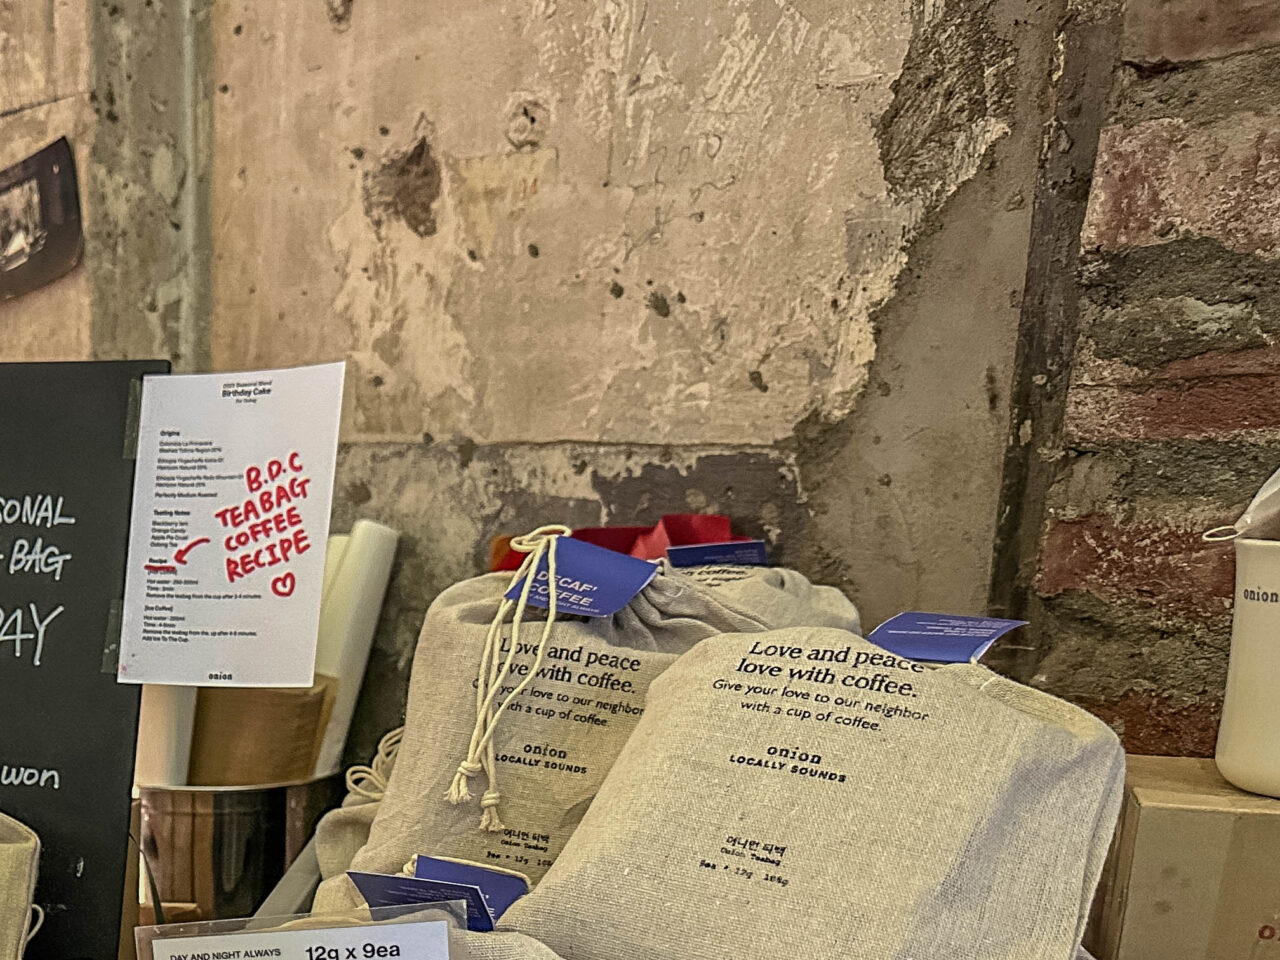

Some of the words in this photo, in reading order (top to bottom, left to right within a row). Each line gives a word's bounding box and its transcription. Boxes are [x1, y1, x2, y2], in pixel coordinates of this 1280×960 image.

[215, 477, 311, 528] TEABAG
[224, 506, 303, 552] COFFEE
[9, 538, 72, 581] BAG
[225, 529, 312, 583] RECIPE
[1244, 586, 1278, 602] onion
[547, 646, 583, 663] and
[585, 651, 641, 672] peace
[748, 641, 803, 660] Love
[807, 646, 848, 665] and
[852, 650, 926, 674] peace
[577, 672, 636, 694] coffee.
[735, 658, 782, 677] love
[788, 664, 836, 685] with
[841, 673, 918, 698] coffee.
[530, 687, 554, 700] love
[713, 679, 743, 692] Give
[744, 684, 778, 696] your
[781, 686, 811, 701] love
[814, 692, 830, 703] to
[834, 696, 861, 708] our
[864, 700, 930, 721] neighbor
[535, 706, 555, 720] cup
[740, 700, 771, 714] with
[786, 707, 812, 721] cup
[815, 710, 833, 723] of
[835, 714, 882, 732] coffee.
[523, 743, 568, 759] onion
[766, 746, 822, 766] onion
[0, 764, 61, 789] won
[495, 754, 540, 766] LOCALLY
[543, 761, 588, 774] SOUNDS
[729, 754, 787, 771] LOCALLY
[790, 765, 847, 783] SOUNDS
[212, 951, 241, 960] NIGHT
[243, 948, 281, 958] ALWAYS
[345, 947, 358, 960] x
[362, 943, 401, 958] 9ea
